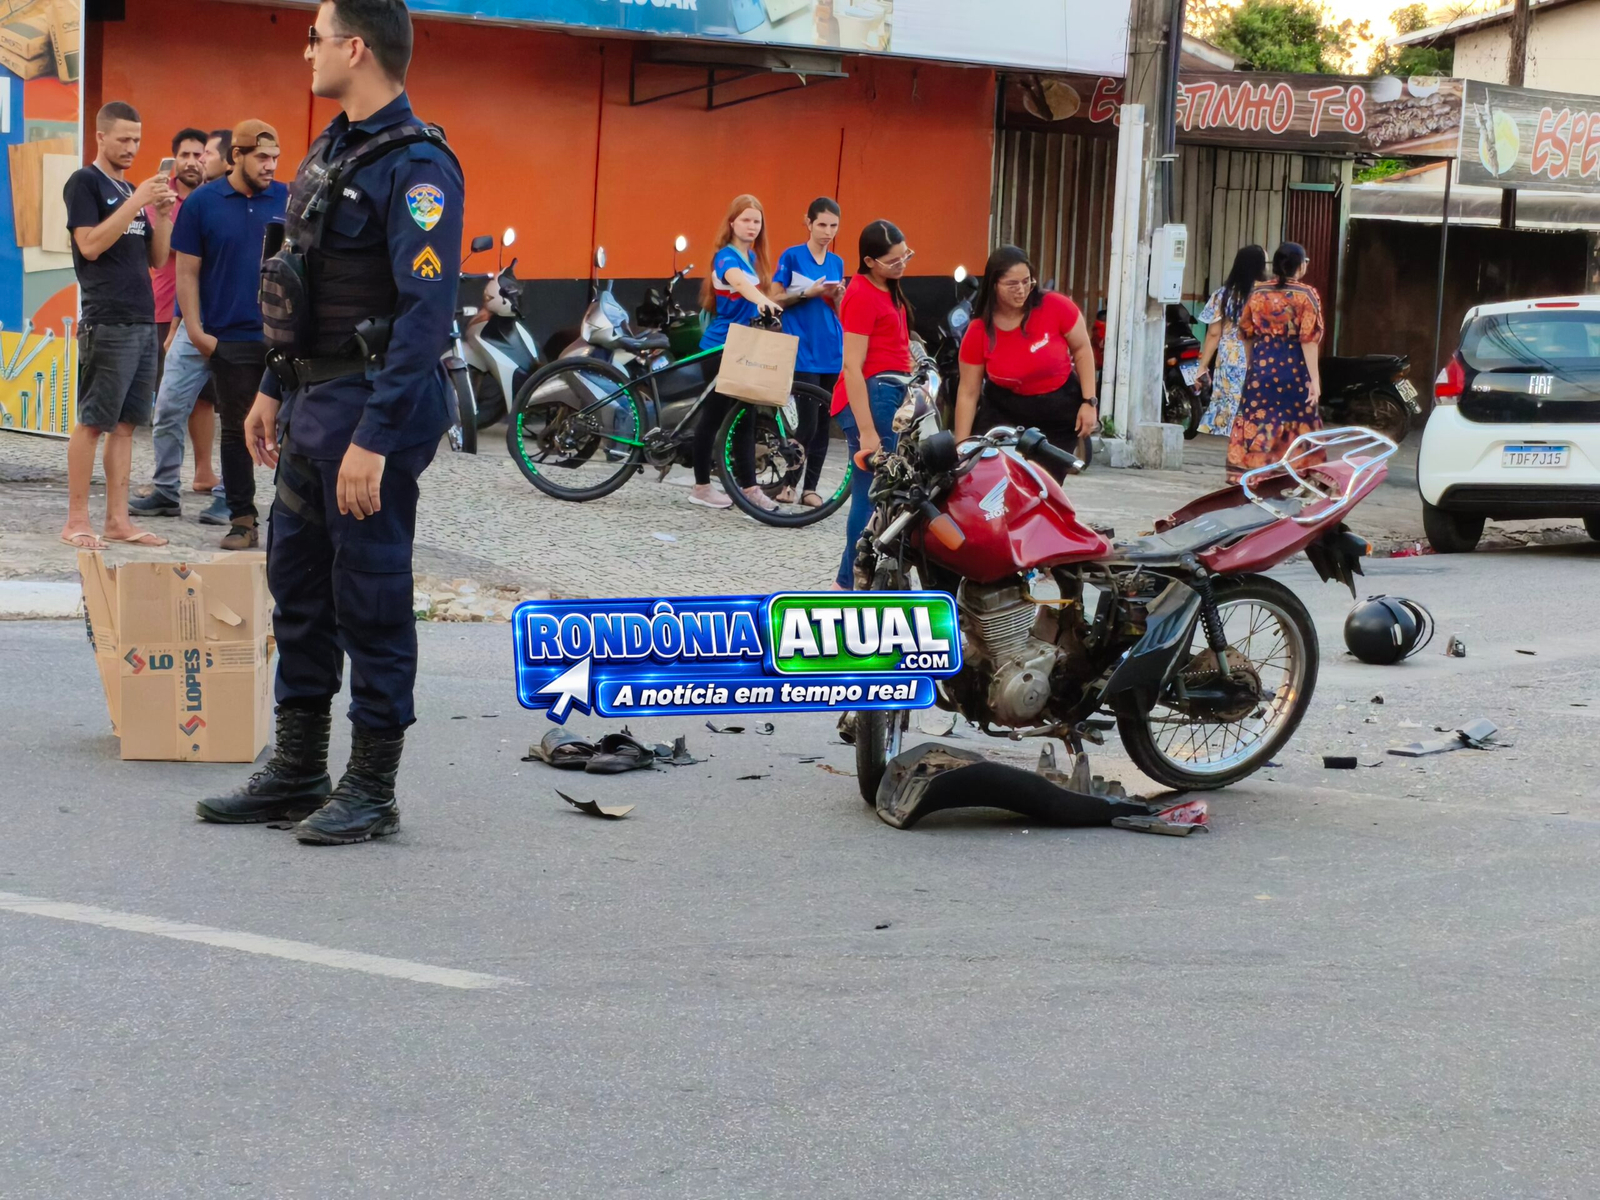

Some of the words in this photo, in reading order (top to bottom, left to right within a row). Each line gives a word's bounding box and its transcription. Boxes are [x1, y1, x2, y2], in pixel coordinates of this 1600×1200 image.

[1308, 86, 1366, 138] T-8
[1530, 106, 1600, 181] ESPE
[1528, 375, 1554, 395] FIAT
[1509, 453, 1562, 465] TDF7J15
[184, 648, 203, 711] LOPES
